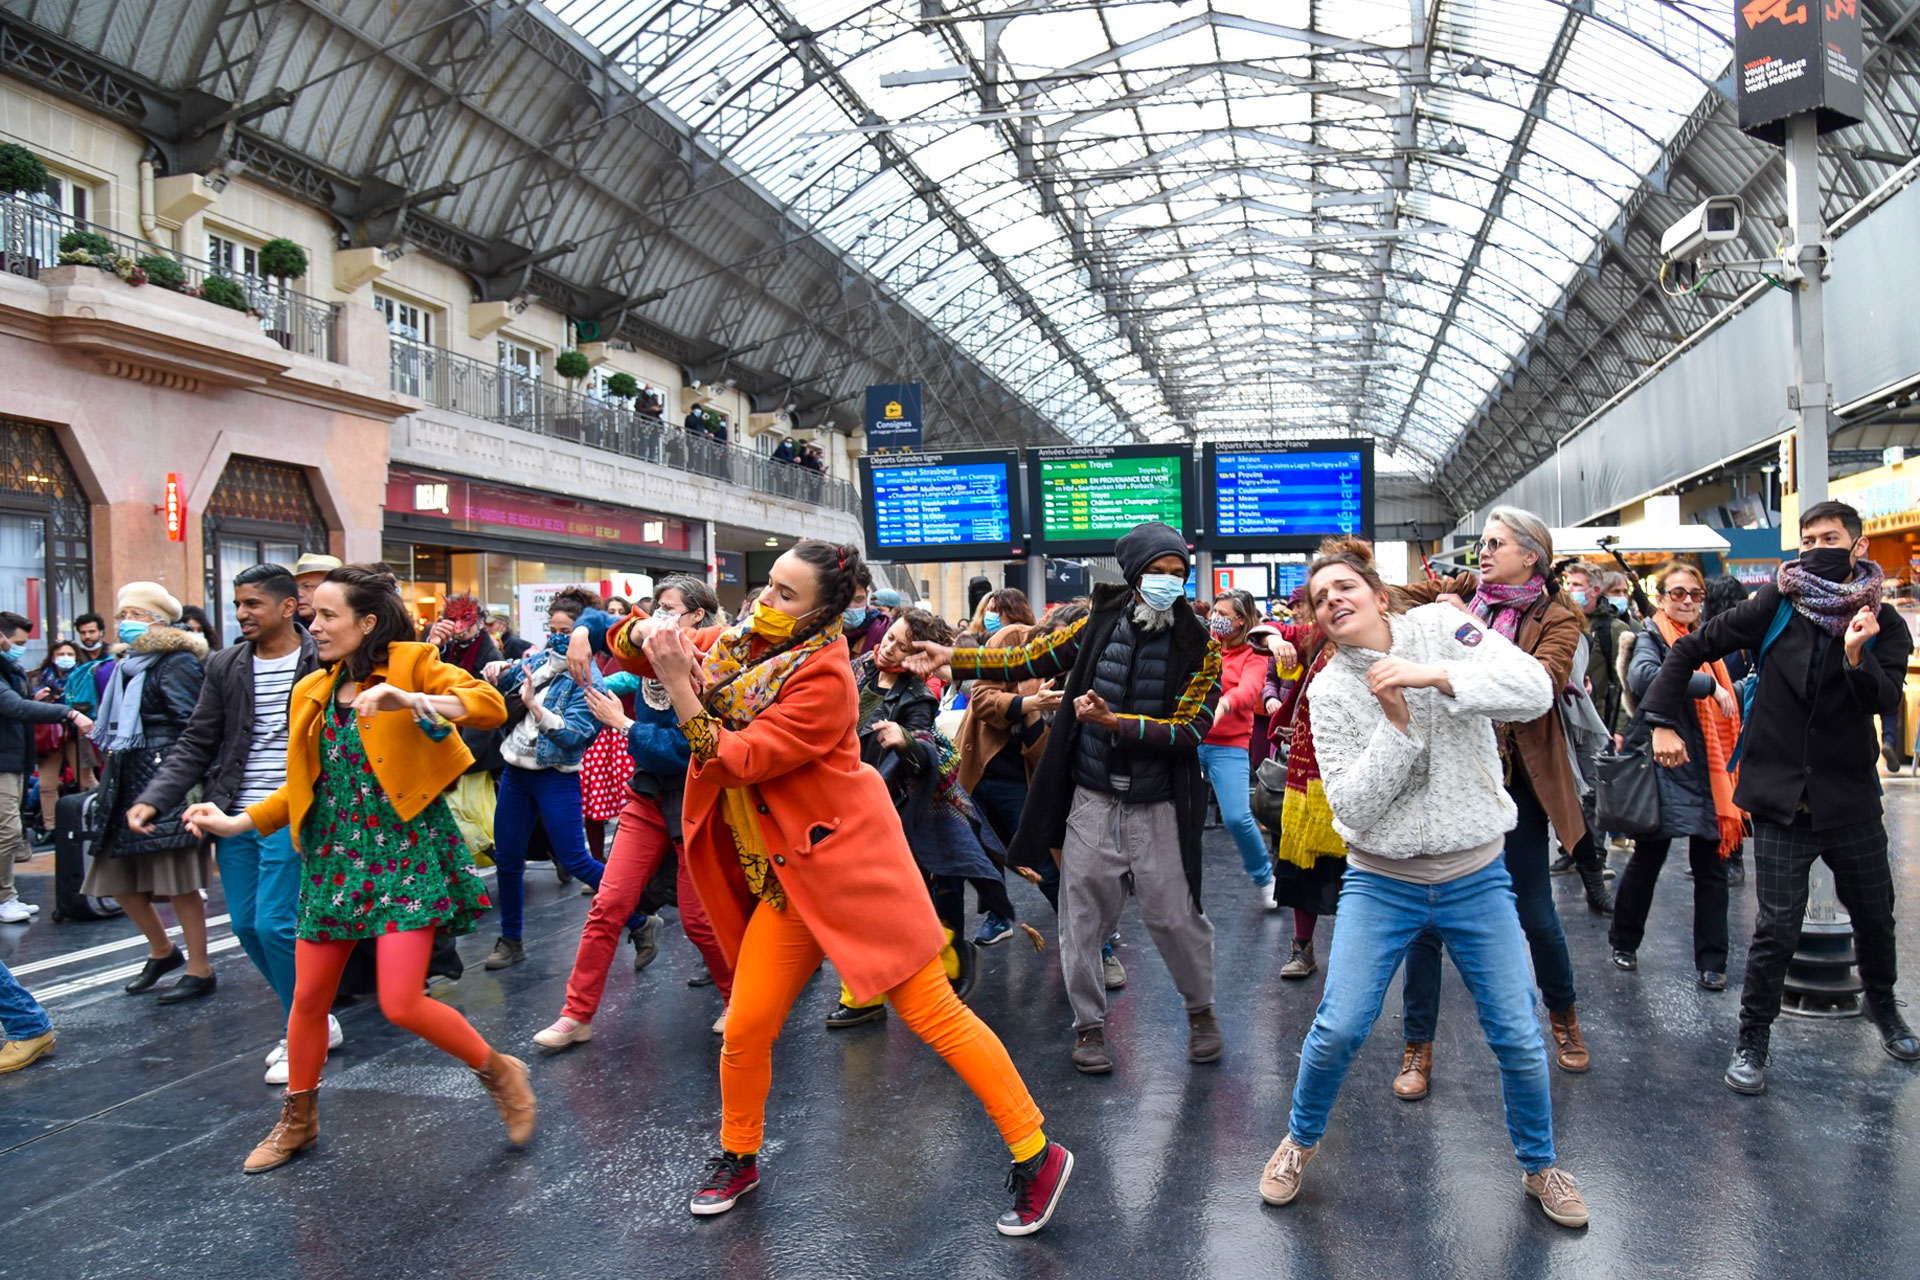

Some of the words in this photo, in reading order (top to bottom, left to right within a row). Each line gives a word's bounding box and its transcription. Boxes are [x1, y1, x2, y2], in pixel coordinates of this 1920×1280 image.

[876, 421, 912, 430] Consignes
[1216, 442, 1241, 451] Départs
[1038, 448, 1065, 457] Arrivées
[1066, 447, 1094, 455] Grandes
[1095, 446, 1115, 455] lignes
[870, 456, 896, 465] Départs
[896, 455, 922, 463] Grandes
[923, 454, 943, 463] lignes
[1238, 455, 1260, 463] Meaux
[1089, 461, 1113, 470] Troyes
[919, 468, 957, 477] Strasbourg
[1138, 467, 1157, 475] Troyes
[1238, 471, 1263, 479] Provins
[1100, 476, 1140, 485] PROVENANCE
[1130, 482, 1155, 490] Forbach
[1238, 487, 1279, 495] Coulommiers
[1090, 492, 1110, 500] Troyes
[1238, 494, 1259, 502] Meaux
[1090, 499, 1115, 507] Châlons
[1124, 498, 1159, 507] Champagne
[1239, 502, 1259, 510] Meaux
[1337, 471, 1357, 533] départ
[167, 482, 178, 532] TABAC
[921, 506, 941, 514] Troyes
[1090, 514, 1115, 522] Châlons
[1124, 513, 1159, 522] Champagne
[1239, 510, 1260, 518] Provins
[464, 506, 475, 519] BE
[508, 511, 519, 526] BE
[519, 513, 541, 528] RELAX
[544, 518, 552, 530] BE
[595, 525, 603, 537] BE
[604, 527, 620, 539] RELAY
[1239, 518, 1264, 526] Château
[1264, 517, 1286, 527] Thierry
[1238, 525, 1279, 534] Coulommiers
[924, 535, 949, 544] Stuttgart
[534, 595, 545, 603] EN
